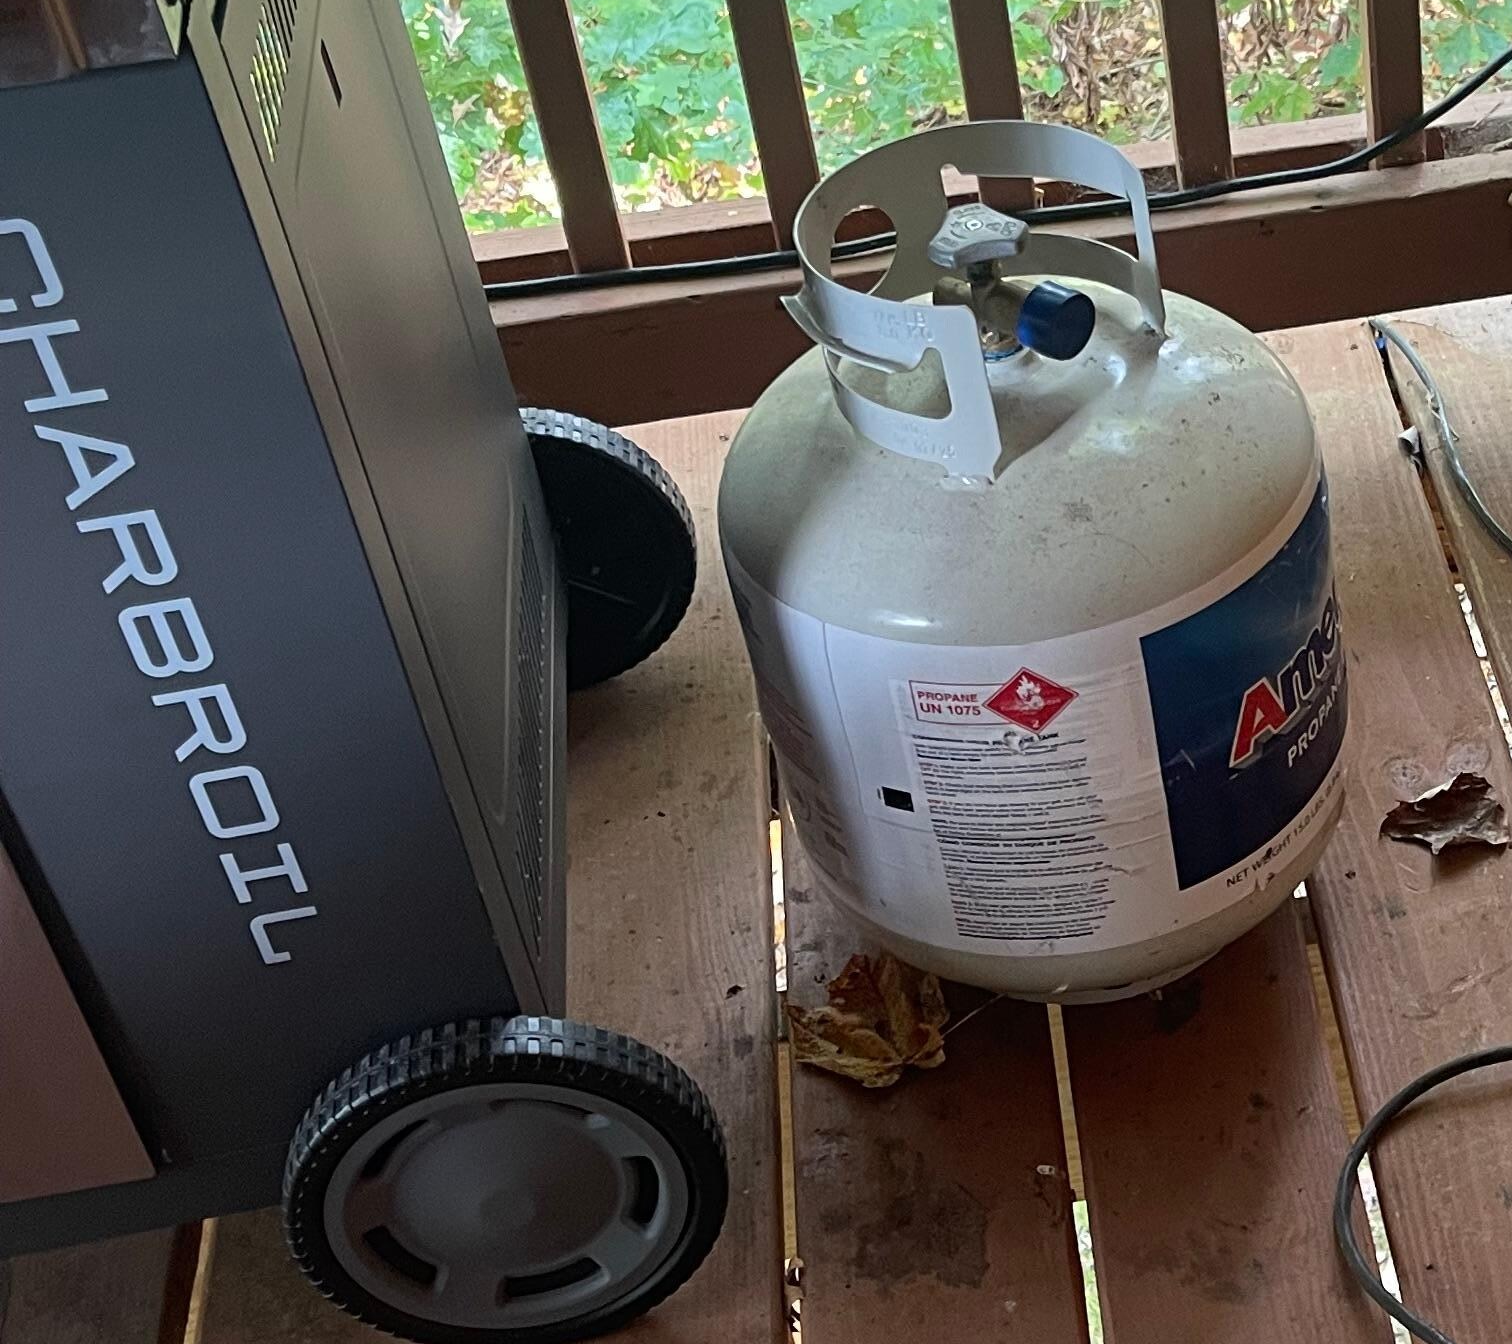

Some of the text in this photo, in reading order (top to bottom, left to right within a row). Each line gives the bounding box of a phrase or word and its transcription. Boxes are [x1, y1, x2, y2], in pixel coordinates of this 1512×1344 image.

[0, 218, 318, 965] CHARBROIL
[917, 690, 978, 704] PROPANE
[1228, 595, 1343, 768] Ame
[919, 703, 981, 716] UN 1075
[1226, 867, 1250, 887] NET
[1252, 834, 1292, 870] WEGHT
